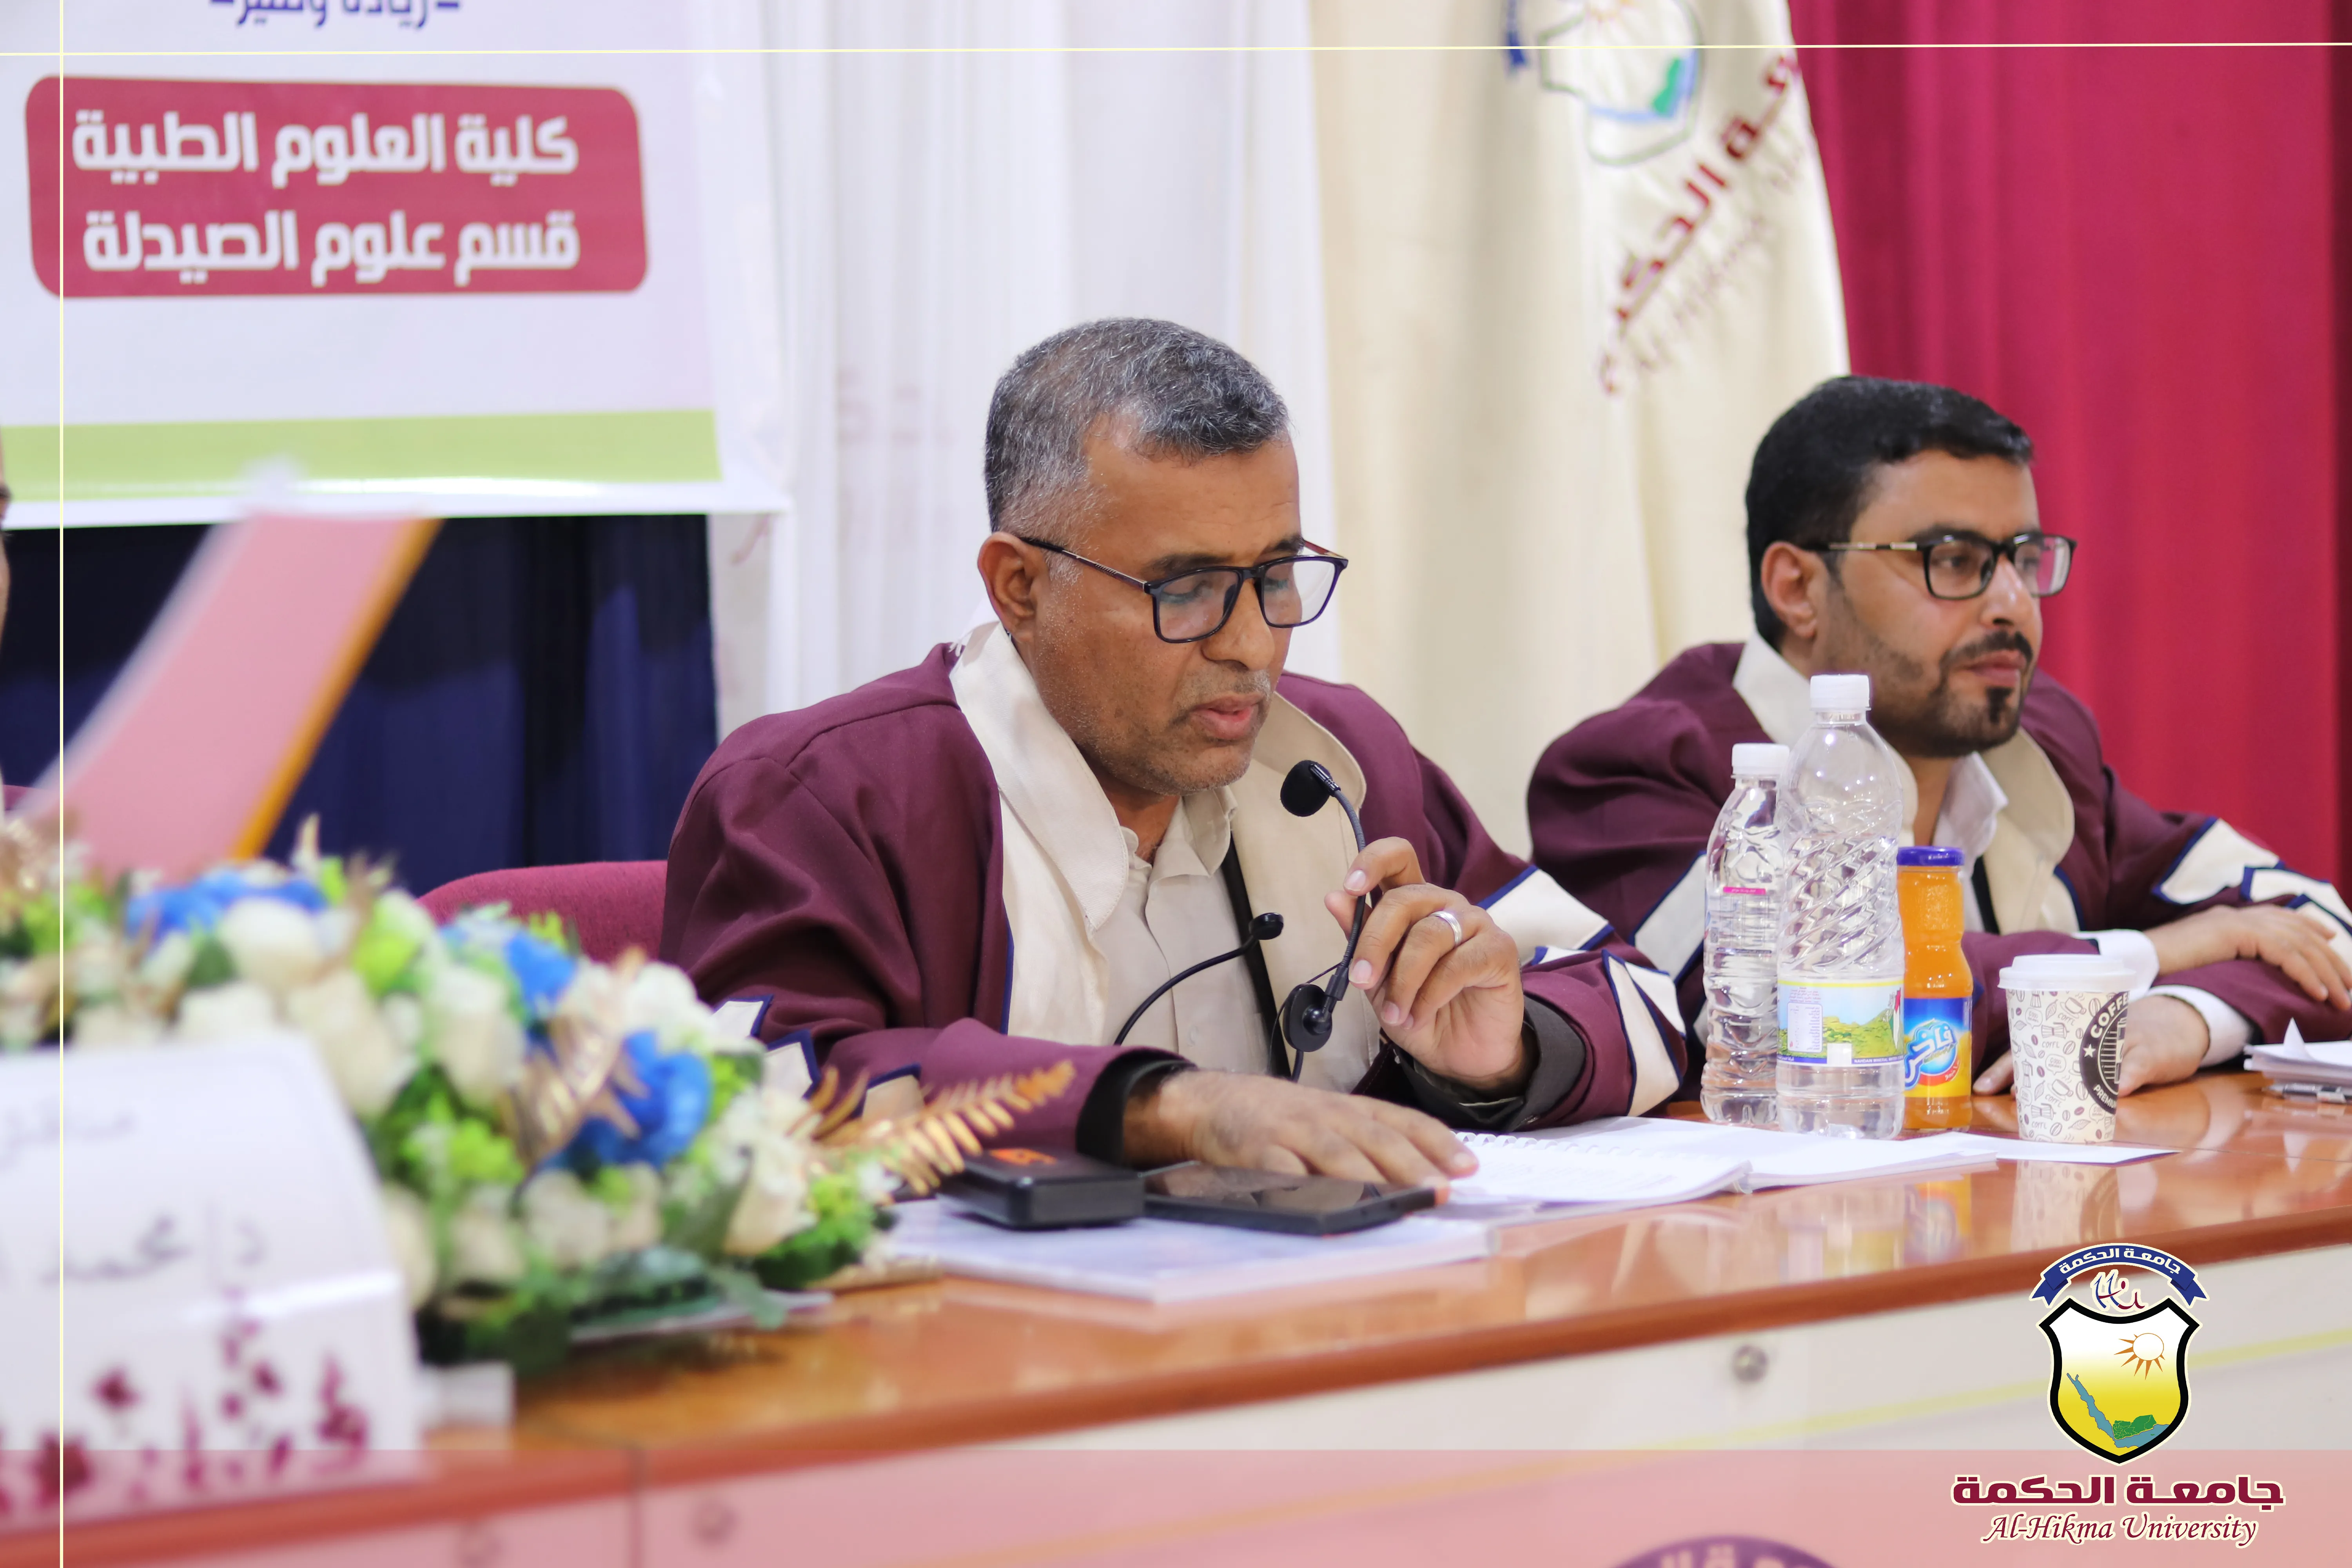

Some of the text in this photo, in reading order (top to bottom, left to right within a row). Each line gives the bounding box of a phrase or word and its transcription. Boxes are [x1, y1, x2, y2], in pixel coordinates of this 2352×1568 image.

[72, 110, 579, 189] كلية العلوم الطبية
[83, 211, 580, 287] قسم علوم الصيدلة
[1905, 1025, 1954, 1083] فاخر
